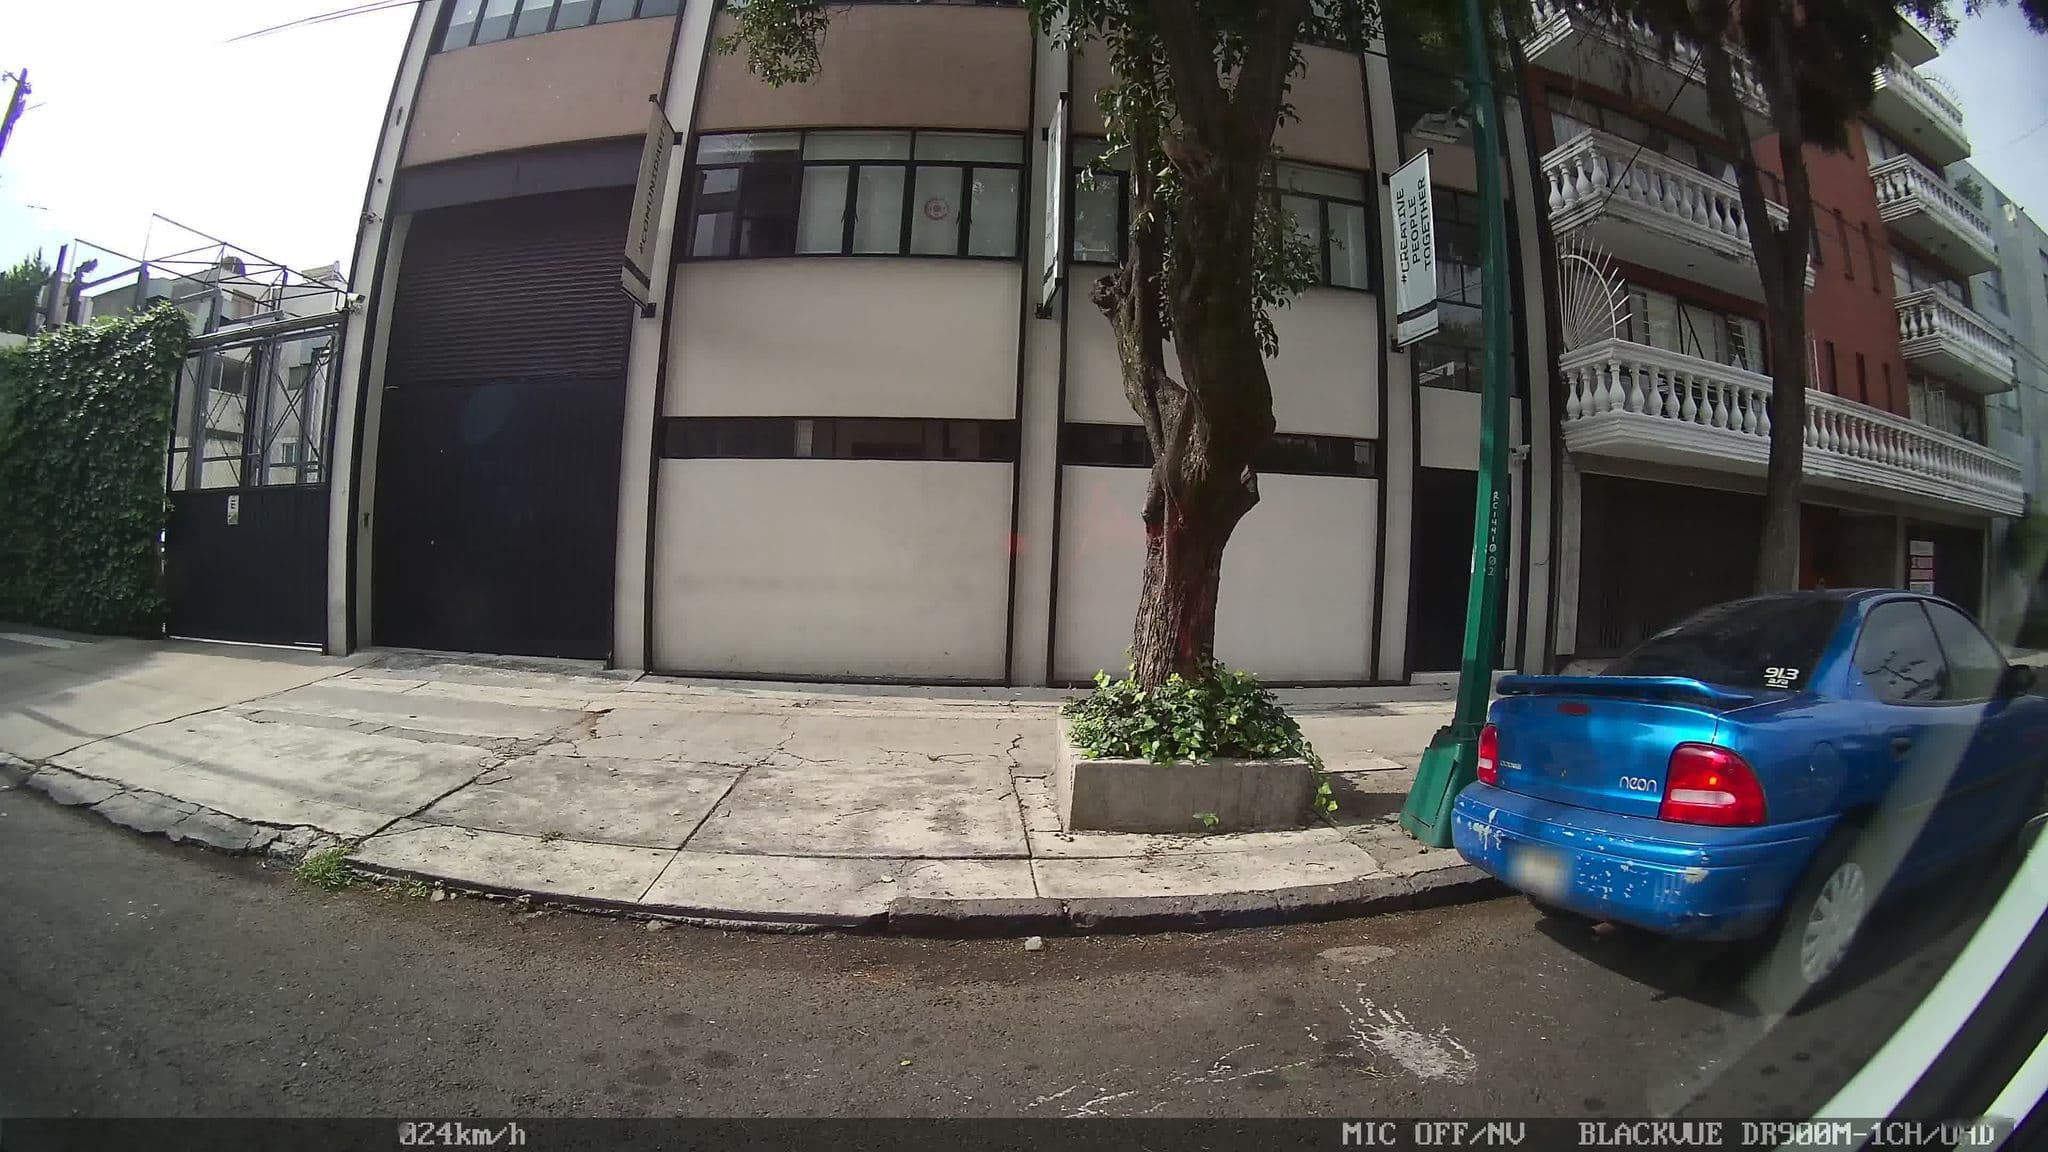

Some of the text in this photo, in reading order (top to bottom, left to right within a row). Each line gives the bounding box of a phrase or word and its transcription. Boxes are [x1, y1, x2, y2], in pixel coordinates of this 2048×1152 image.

[1396, 188, 1410, 284] #CREATIVE
[1407, 196, 1421, 265] PEOPLE
[1417, 176, 1432, 272] TOGETHER
[1619, 776, 1657, 793] neon
